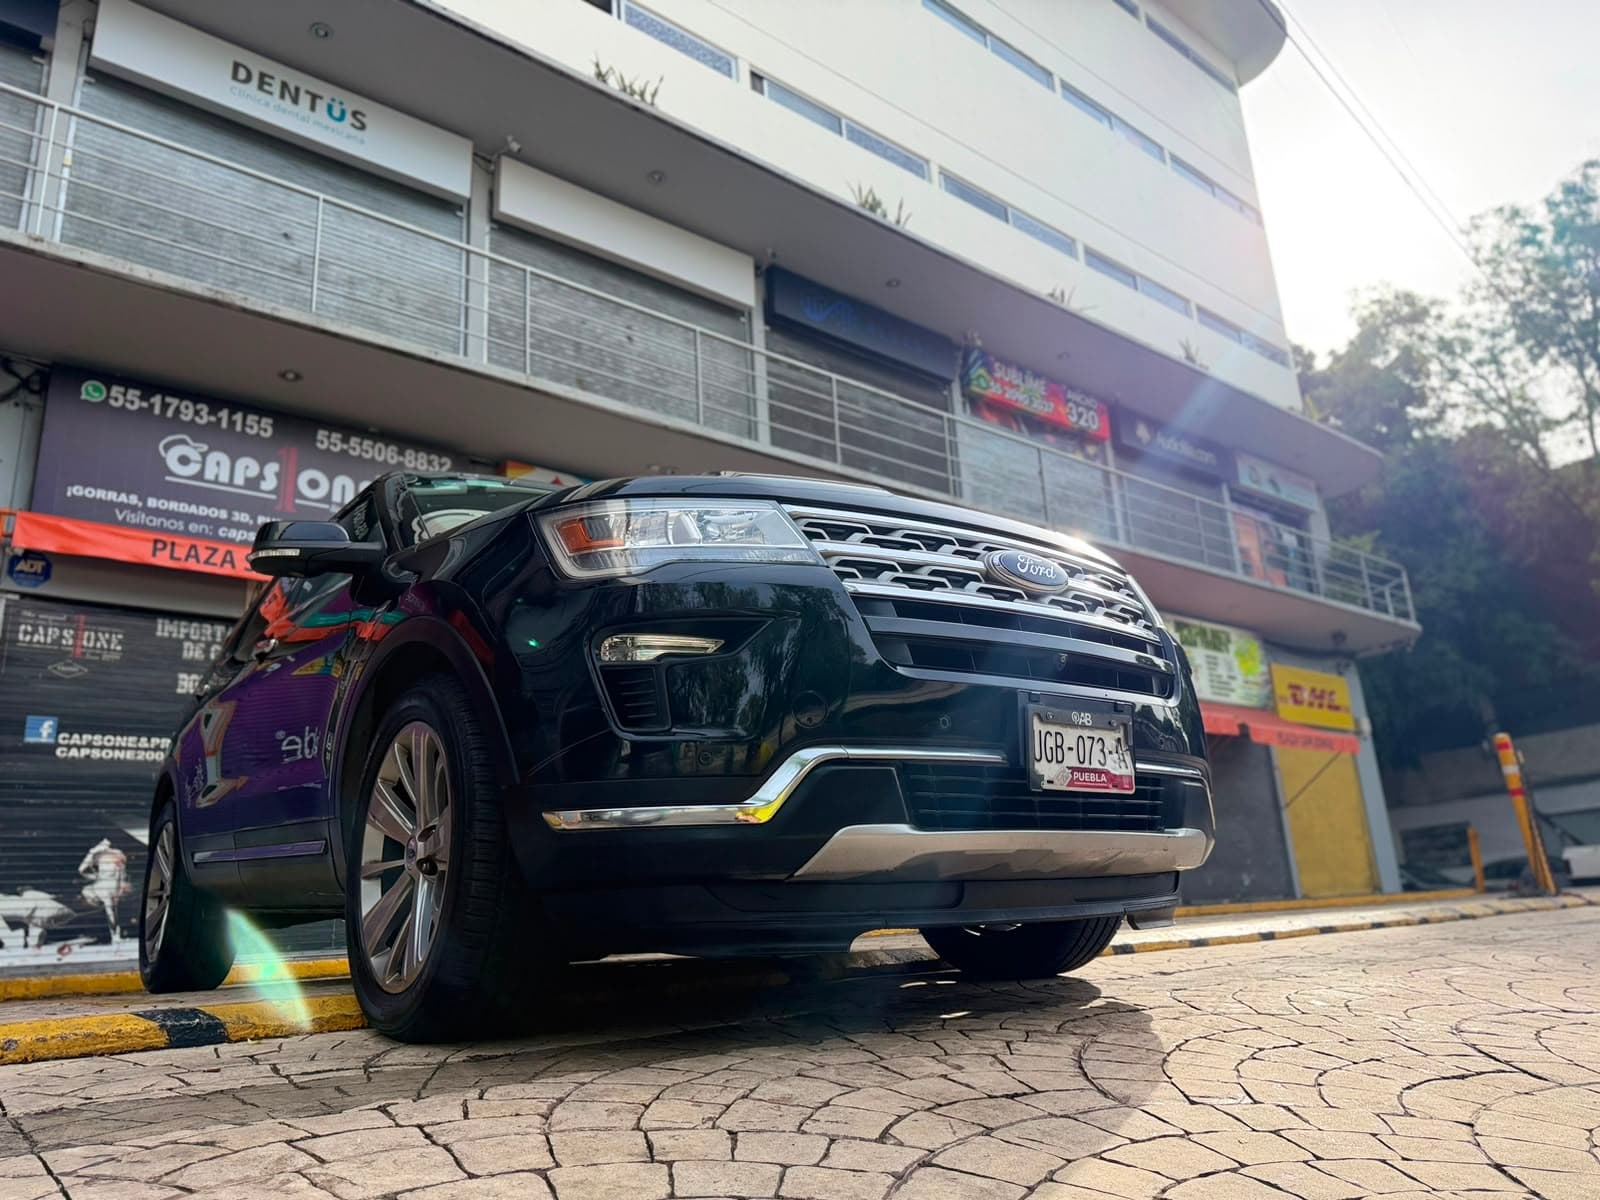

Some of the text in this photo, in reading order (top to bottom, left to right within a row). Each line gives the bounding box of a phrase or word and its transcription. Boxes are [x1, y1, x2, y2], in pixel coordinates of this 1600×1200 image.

[231, 60, 368, 131] DENTÜS
[108, 384, 274, 438] 55-1793-1155
[1067, 402, 1099, 430] 320
[315, 429, 452, 472] 55-5506-8832
[146, 496, 229, 520] BORDADOS
[15, 559, 46, 574] ADT
[151, 538, 237, 570] PLAZA
[1016, 554, 1058, 580] Ford
[1287, 682, 1342, 712] DHL
[1073, 771, 1108, 783] PUEBLA
